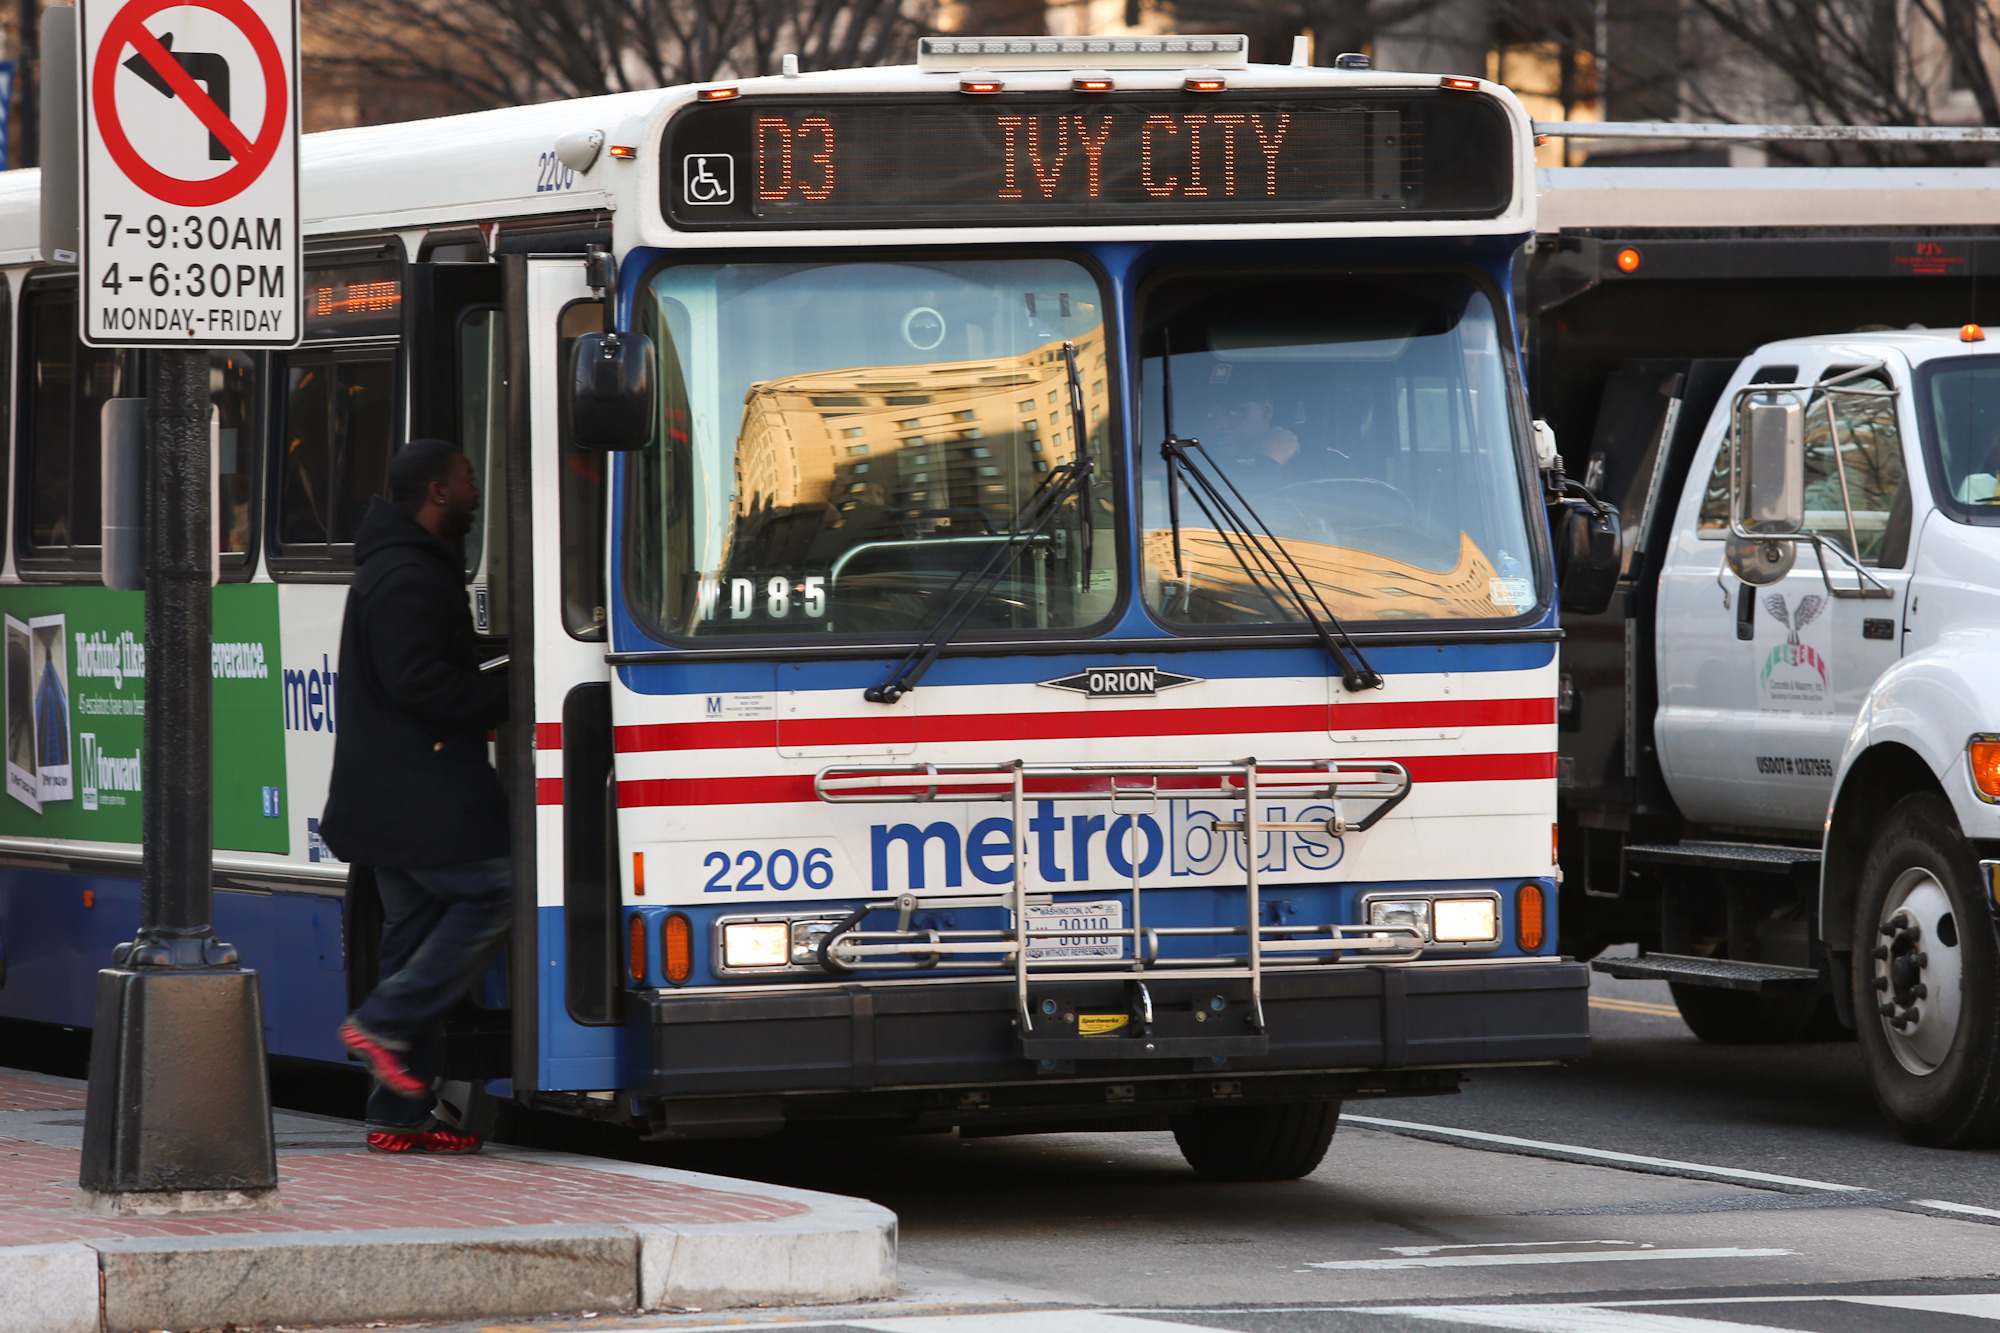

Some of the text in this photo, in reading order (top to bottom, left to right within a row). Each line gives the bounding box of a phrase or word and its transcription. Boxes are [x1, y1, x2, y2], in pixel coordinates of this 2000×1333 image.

[758, 113, 1290, 200] D3 IVY CITY
[104, 214, 282, 250] 7-9:30AM
[102, 262, 284, 298] 4-6:30PM
[103, 307, 282, 332] MONDAY-FRIDAY
[75, 630, 122, 690] Nothing
[121, 630, 145, 678] like
[1090, 672, 1154, 692] ORION
[97, 746, 142, 792] forward
[1756, 756, 1793, 774] USDOT#
[870, 799, 1345, 892] metrobus
[703, 847, 834, 893] 2206
